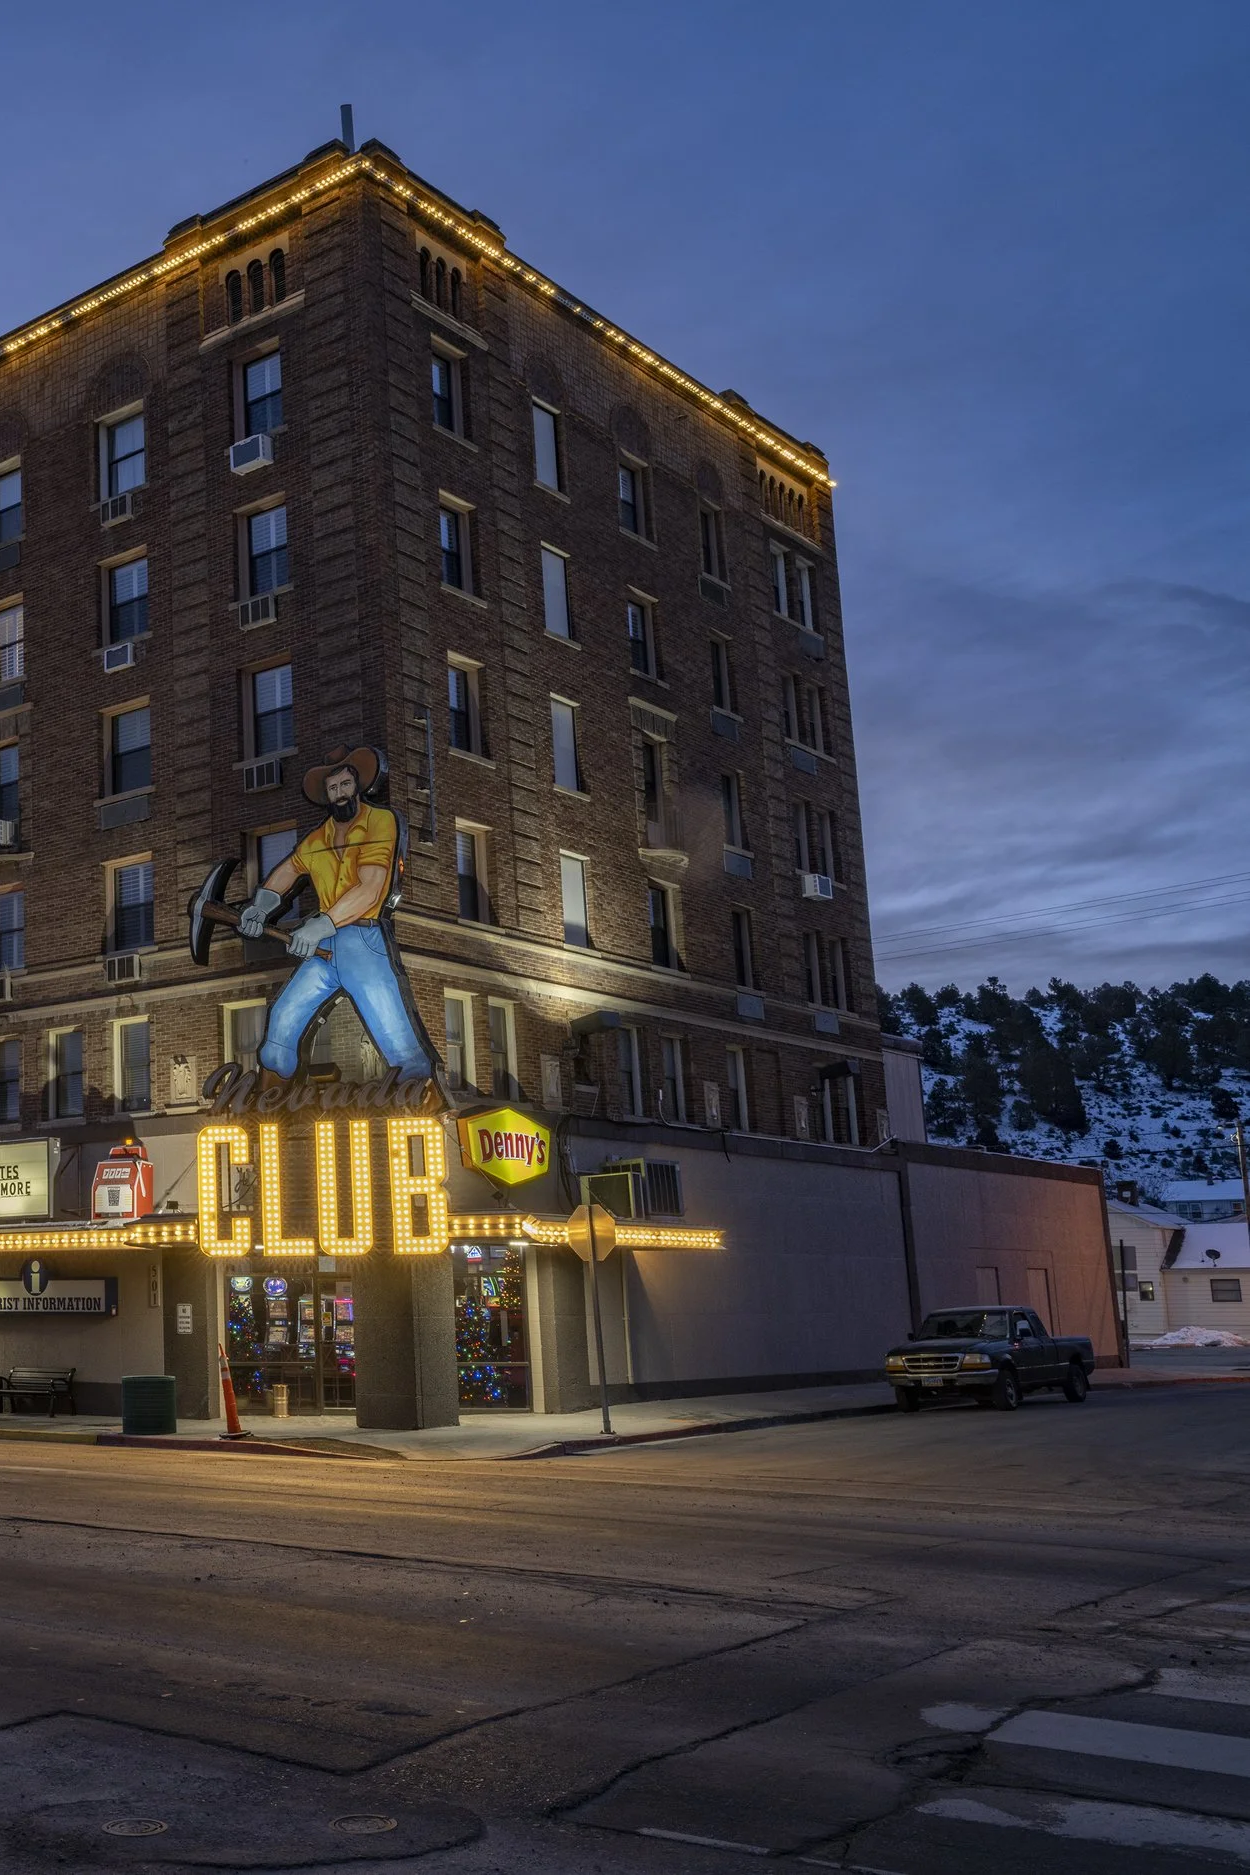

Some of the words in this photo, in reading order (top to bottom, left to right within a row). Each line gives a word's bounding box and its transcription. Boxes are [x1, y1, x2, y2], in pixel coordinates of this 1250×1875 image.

[477, 1128, 546, 1167] Denny's
[0, 1181, 31, 1197] MORE
[197, 1117, 449, 1257] CLUB
[23, 1297, 101, 1311] INFORMATION
